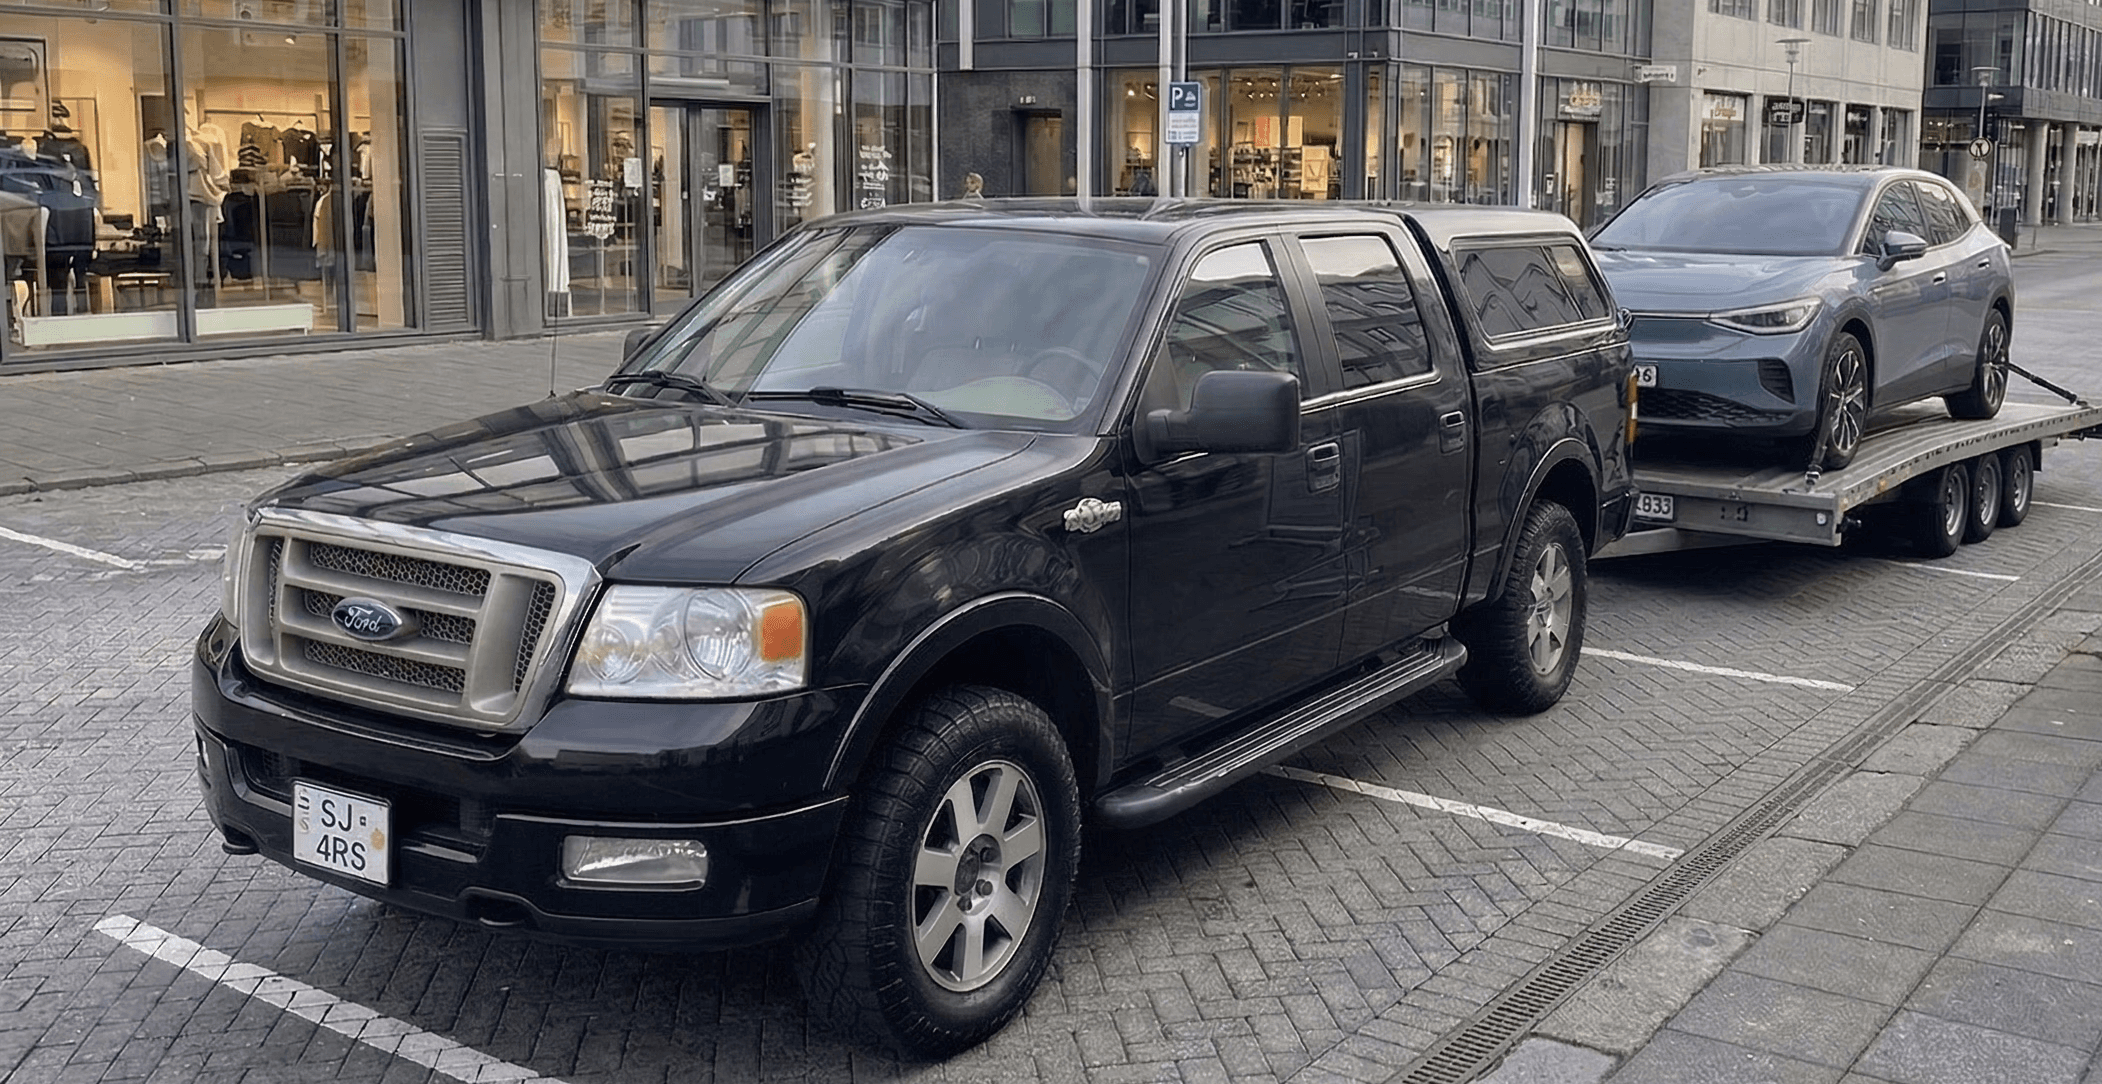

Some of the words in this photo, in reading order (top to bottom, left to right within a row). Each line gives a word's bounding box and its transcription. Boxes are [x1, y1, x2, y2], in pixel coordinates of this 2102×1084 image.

[1171, 86, 1184, 109] P
[344, 605, 383, 633] Ford
[321, 799, 353, 832] SJ
[316, 834, 366, 871] 4RS
